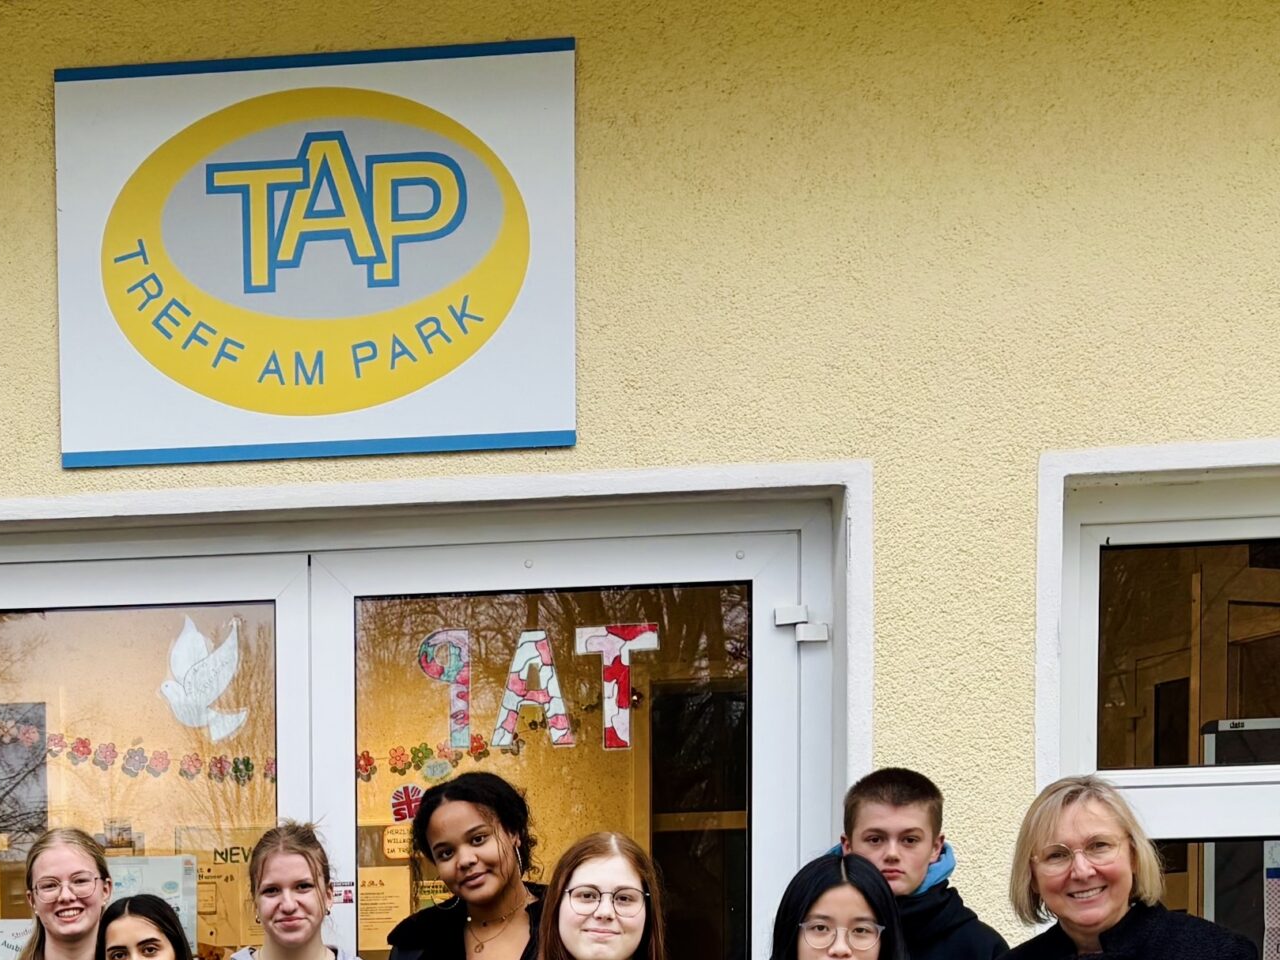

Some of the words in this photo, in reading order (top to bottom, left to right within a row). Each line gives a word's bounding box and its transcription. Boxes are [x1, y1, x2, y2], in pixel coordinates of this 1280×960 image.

[206, 130, 468, 294] TAP
[113, 238, 246, 370] TREFF
[257, 350, 325, 387] AM
[351, 294, 485, 380] PARK
